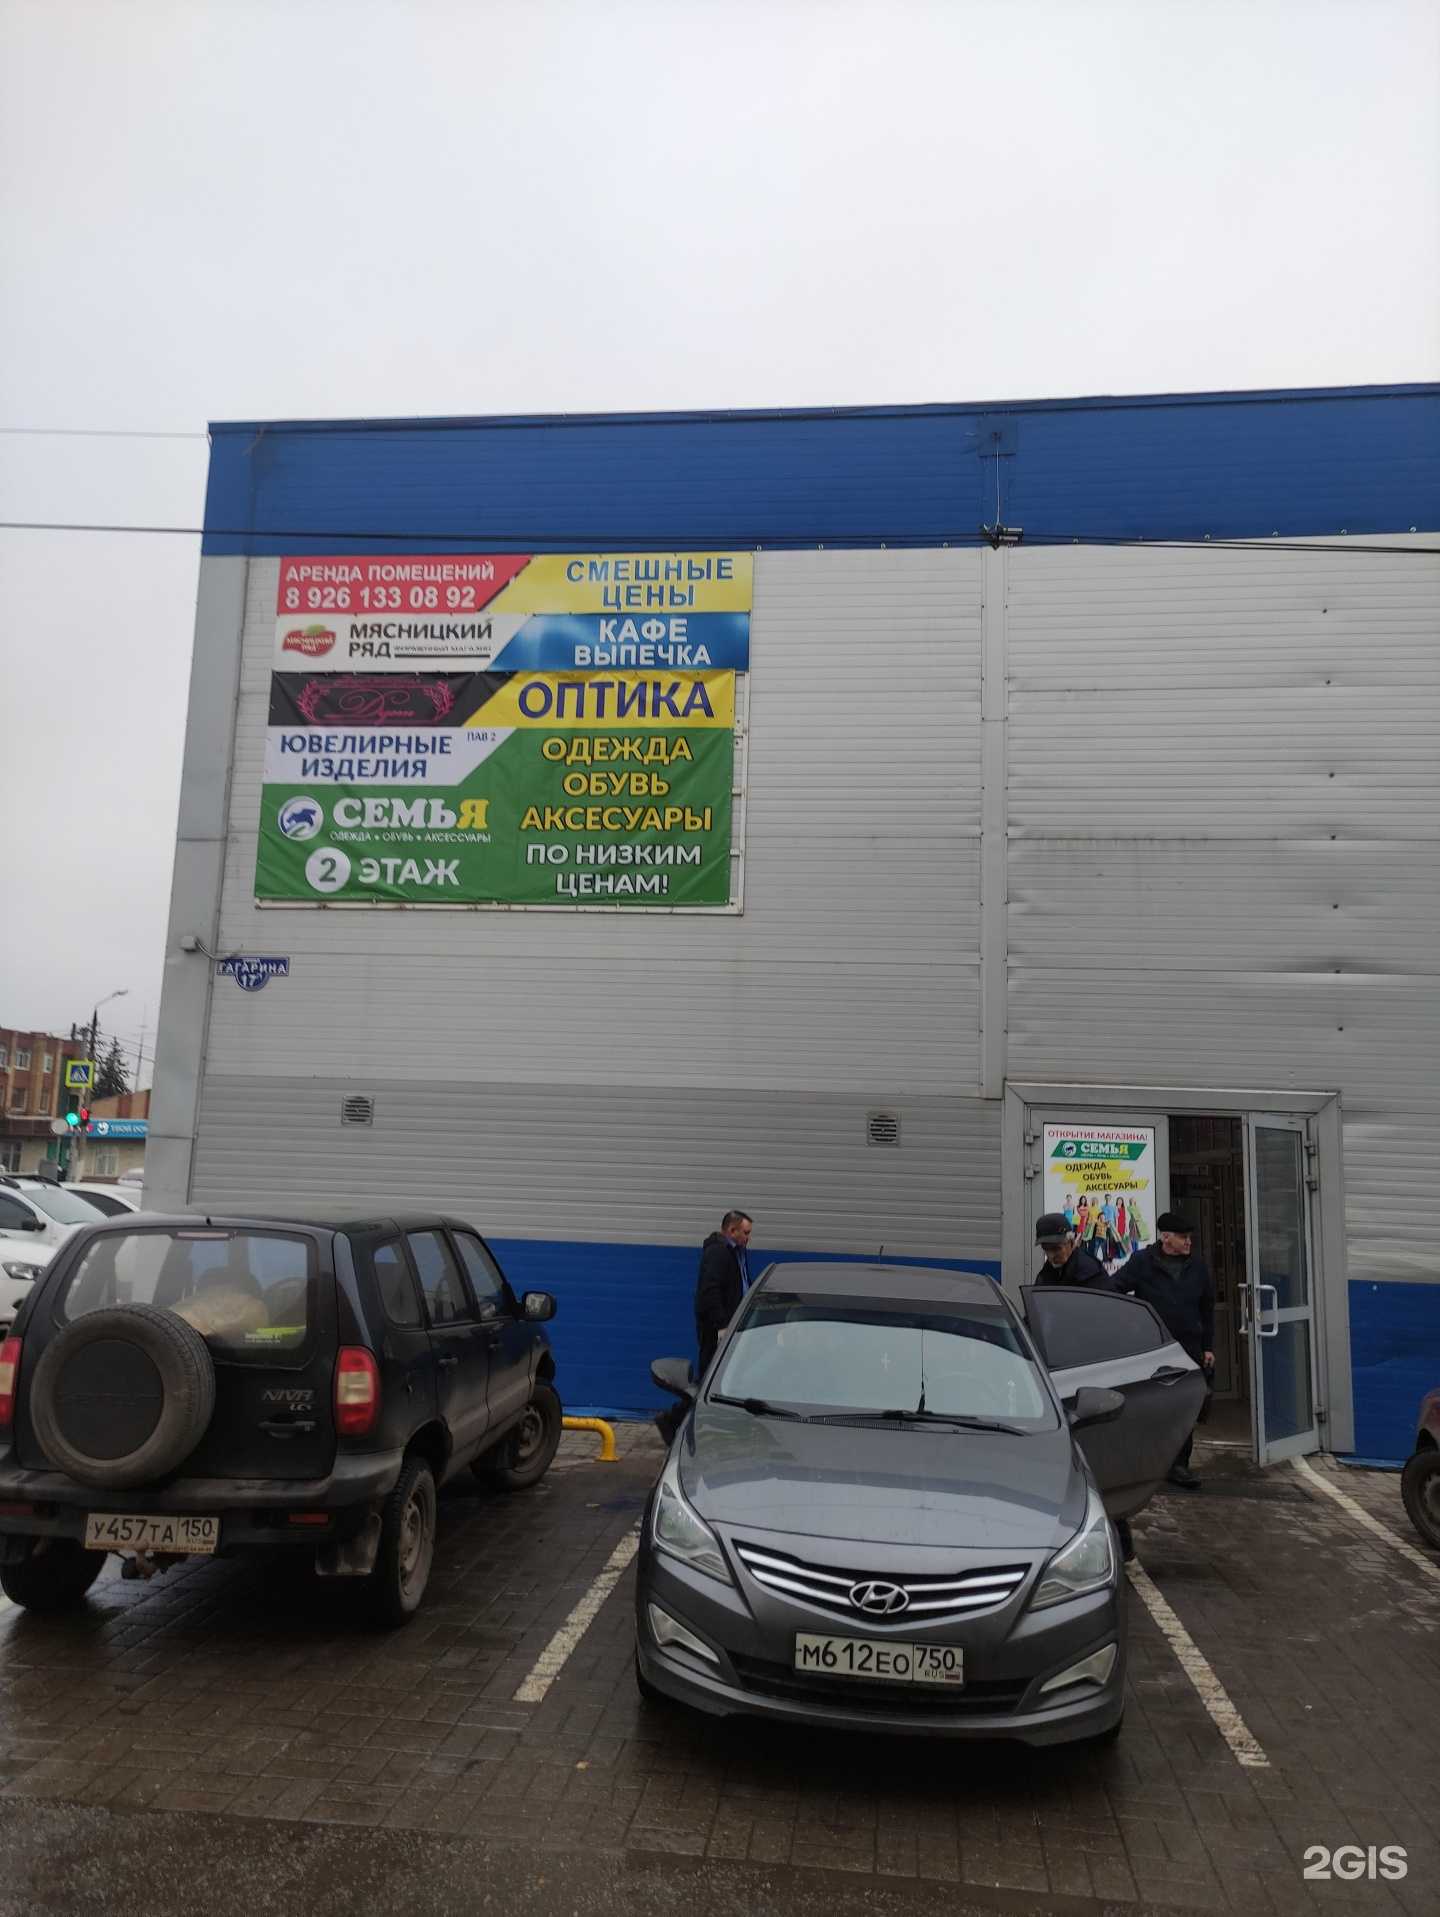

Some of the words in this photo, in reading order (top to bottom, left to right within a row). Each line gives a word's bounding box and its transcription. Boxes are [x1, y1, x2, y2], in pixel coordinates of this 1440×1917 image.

[286, 564, 363, 583] АРЕНДА
[368, 561, 495, 583] ПОМЕЩЕНИЙ
[566, 558, 734, 582] СМЕШНЫЕ
[285, 587, 300, 608] 8
[307, 587, 351, 608] 926
[360, 586, 402, 608] 133
[409, 586, 438, 608] 08
[446, 586, 476, 608] 92
[602, 584, 694, 610] ЦЕНЫ
[350, 618, 493, 640] МЯСНИЦКИЙ
[600, 618, 688, 643] КАФЕ
[349, 642, 391, 659] РЯД
[574, 644, 711, 666] ВЫПЕЧКА
[518, 681, 714, 719] ОПТИКА
[280, 734, 453, 754] ЮВЕЛИРНЫЕ
[542, 737, 693, 766] ОДЕЖДА
[301, 758, 427, 781] ИЗДЕЛИЯ
[563, 772, 670, 796] ОБУВЬ
[332, 797, 490, 829] СЕМЬЯ
[520, 806, 713, 831] АКСЕСУАРЫ
[329, 831, 372, 842] ОДЕЖДА
[382, 832, 414, 842] ОБУВЬ
[526, 843, 569, 865] ПО
[575, 844, 701, 865] НИЗКИМ
[319, 857, 337, 883] 2
[358, 858, 461, 886] ЭТАЖ
[556, 873, 669, 897] ЦЕНАМ!
[1048, 1129, 1095, 1140] ОТКРЫТИЕ
[1080, 1142, 1129, 1154] СЕМЬЯ
[1065, 1162, 1107, 1172] ОДЕЖДА
[1082, 1172, 1112, 1181] ОБУВЬ
[1085, 1182, 1138, 1192] АКСЕСУАРЫ
[94, 1518, 173, 1543] У457ТА
[181, 1519, 213, 1537] 150
[802, 1640, 910, 1675] М612ЕО
[916, 1647, 956, 1670] 750
[924, 1669, 945, 1679] RUS
